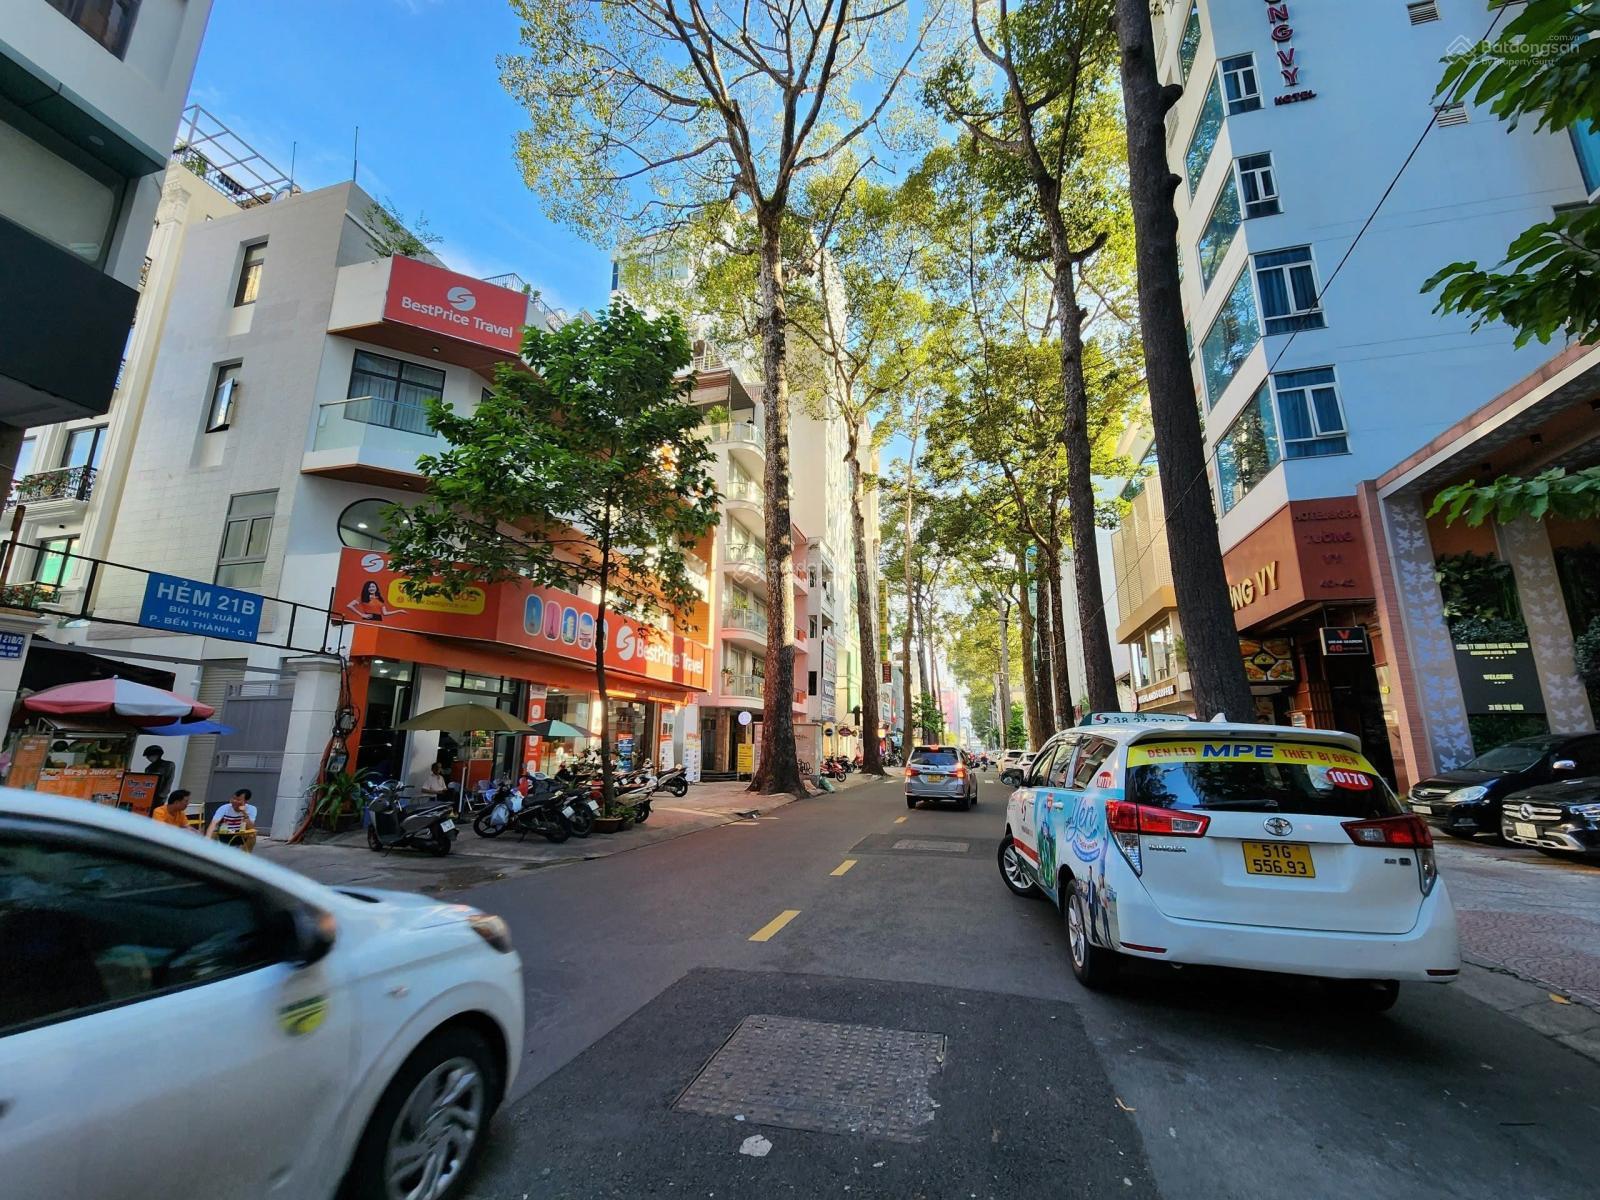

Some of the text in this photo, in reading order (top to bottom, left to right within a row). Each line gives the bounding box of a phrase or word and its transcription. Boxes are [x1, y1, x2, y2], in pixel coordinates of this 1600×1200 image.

[401, 296, 513, 338] BestPrice Travel
[156, 581, 255, 615] HẺM 21B
[1229, 560, 1278, 611] NG VY
[149, 614, 160, 623] P.
[164, 616, 189, 628] BẾN
[192, 621, 229, 634] THÀNH
[636, 637, 704, 675] BestPrice Travel
[1174, 747, 1197, 756] LED
[1202, 744, 1274, 758] MPE
[1262, 844, 1291, 859] 51G
[1253, 859, 1307, 875] 556.93
